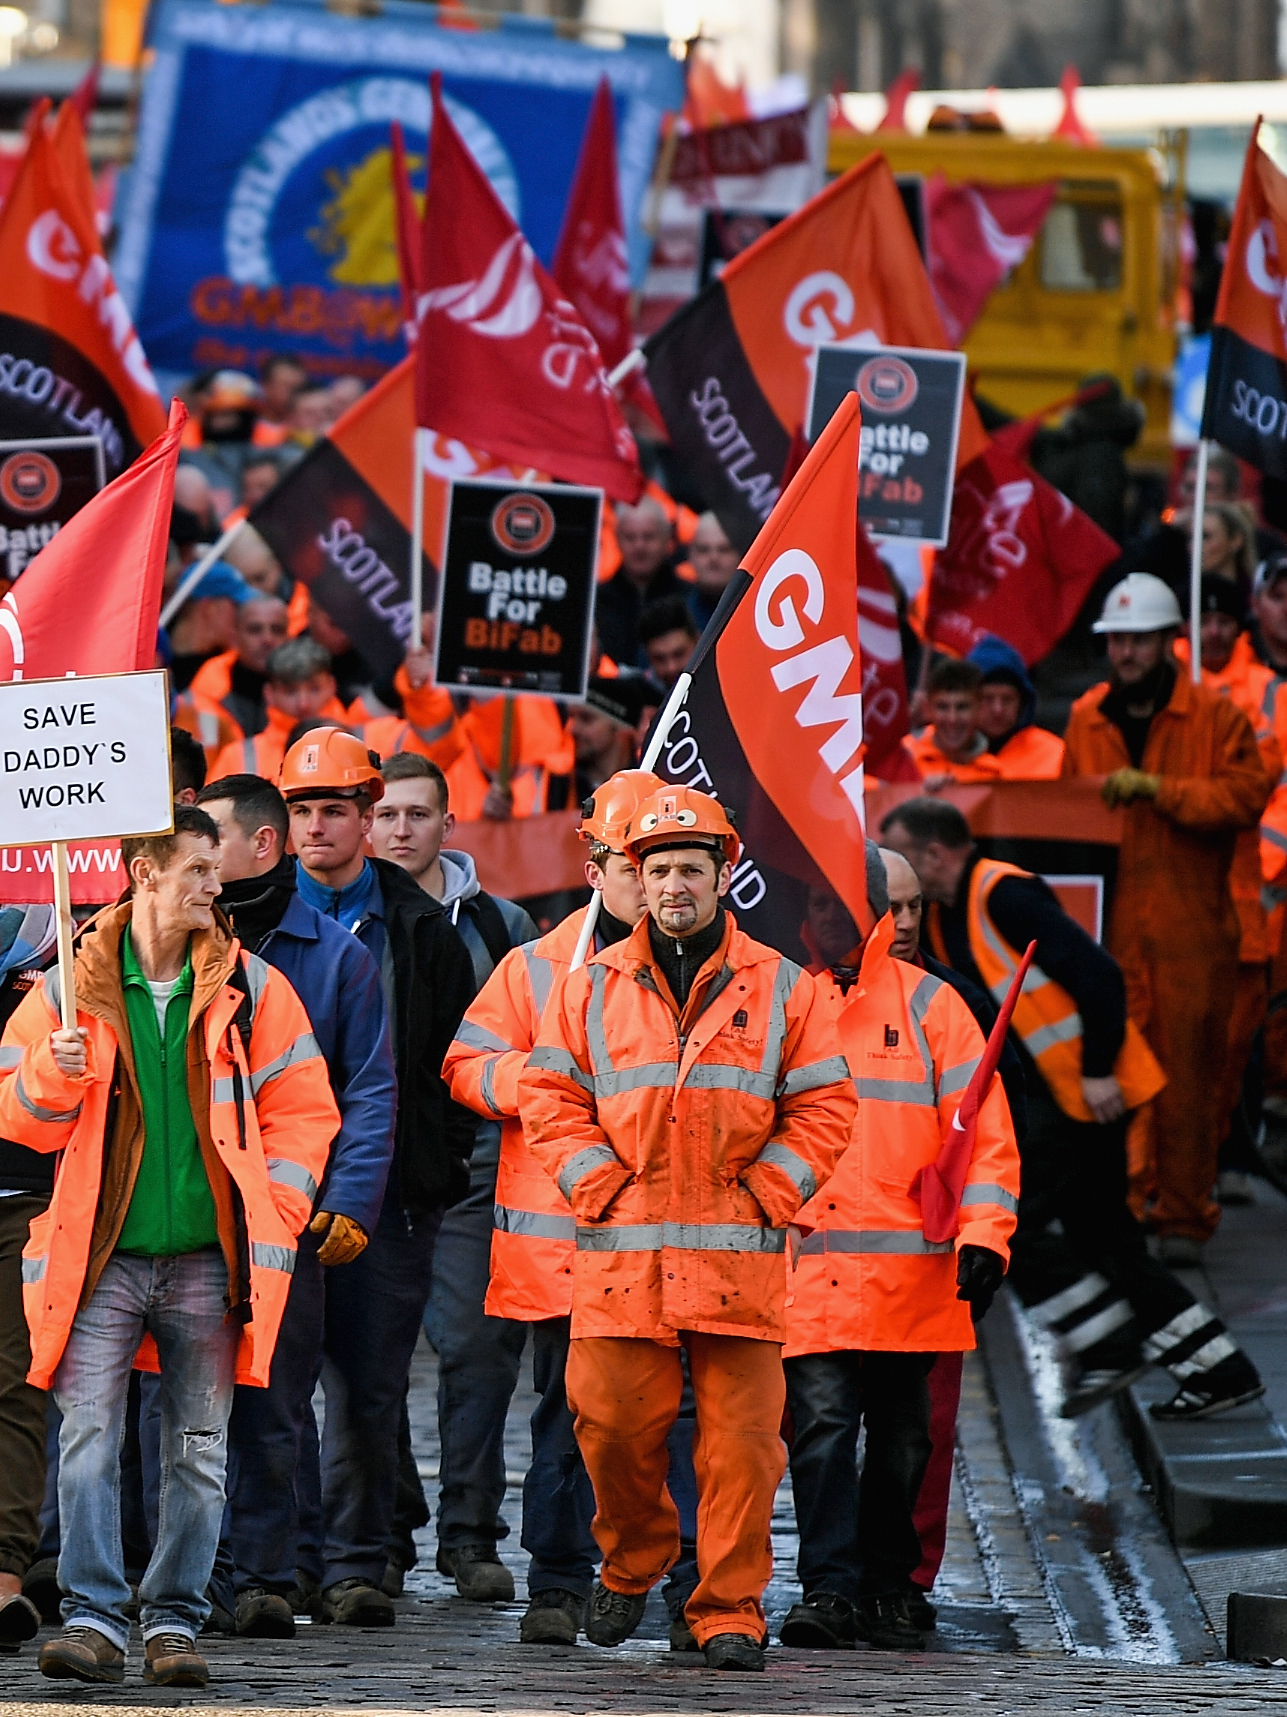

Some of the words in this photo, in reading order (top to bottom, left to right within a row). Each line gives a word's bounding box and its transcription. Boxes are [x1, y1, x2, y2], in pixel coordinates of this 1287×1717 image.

[860, 423, 930, 455] attle
[469, 560, 568, 599] Battle
[486, 591, 542, 623] For
[464, 617, 562, 655] BiFab
[23, 702, 97, 730] SAVE
[18, 781, 106, 809] WORK
